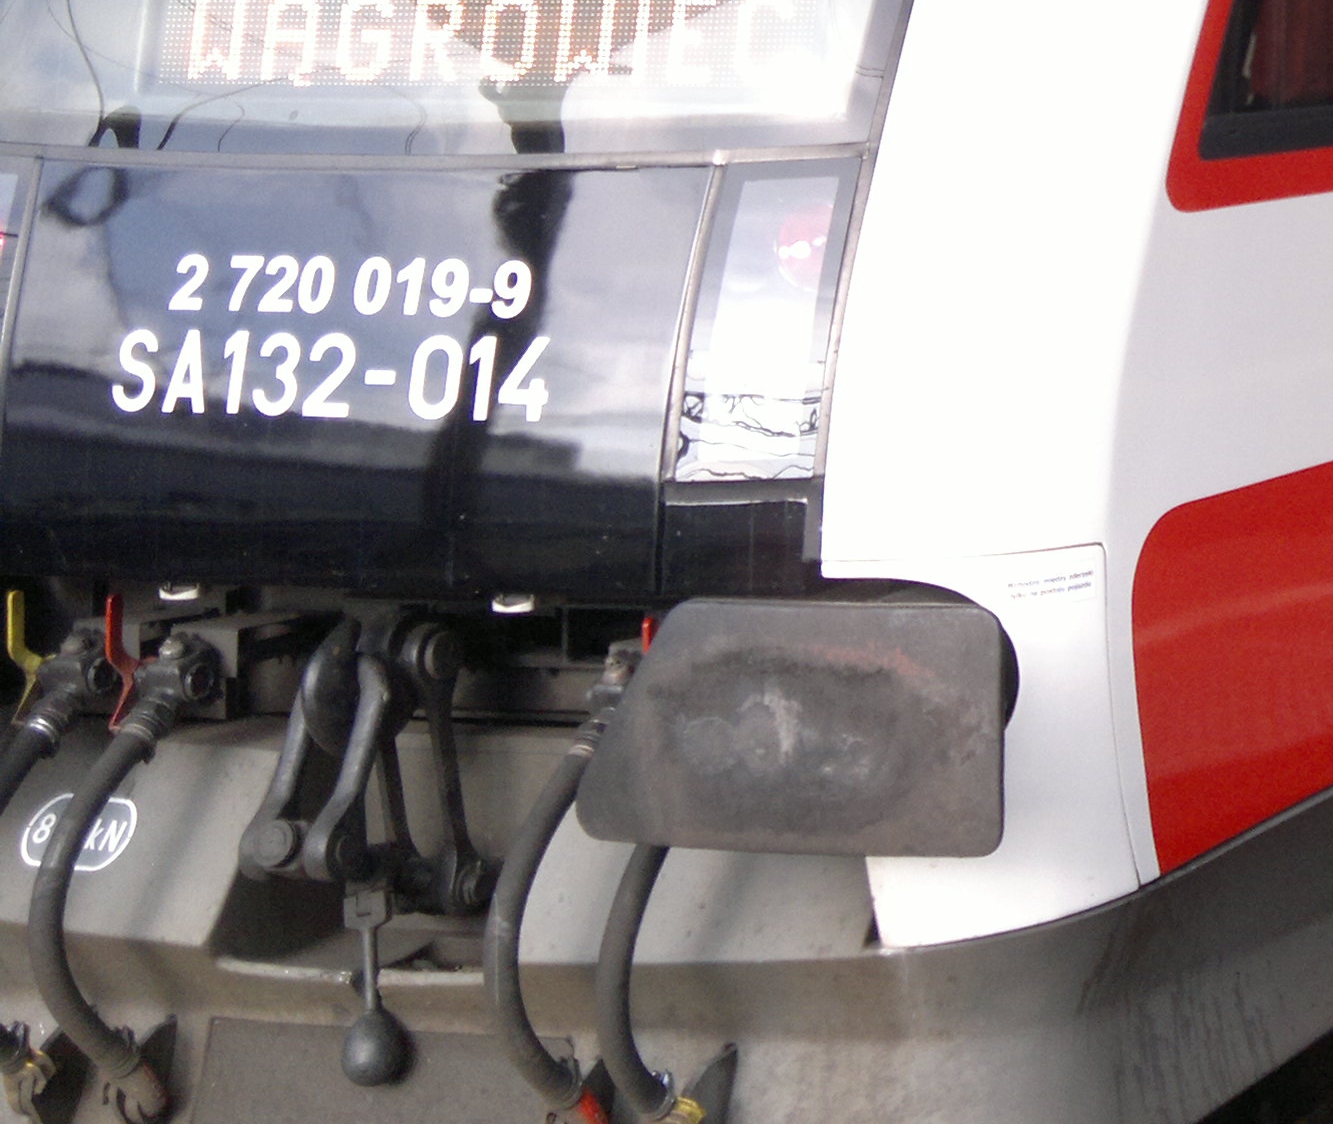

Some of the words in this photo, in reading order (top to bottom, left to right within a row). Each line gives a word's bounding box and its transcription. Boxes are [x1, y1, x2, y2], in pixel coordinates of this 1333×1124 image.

[168, 253, 210, 311] 2
[228, 255, 337, 314] 720
[353, 256, 533, 319] 019-9
[111, 328, 551, 422] SA132-014
[83, 818, 128, 852] kN
